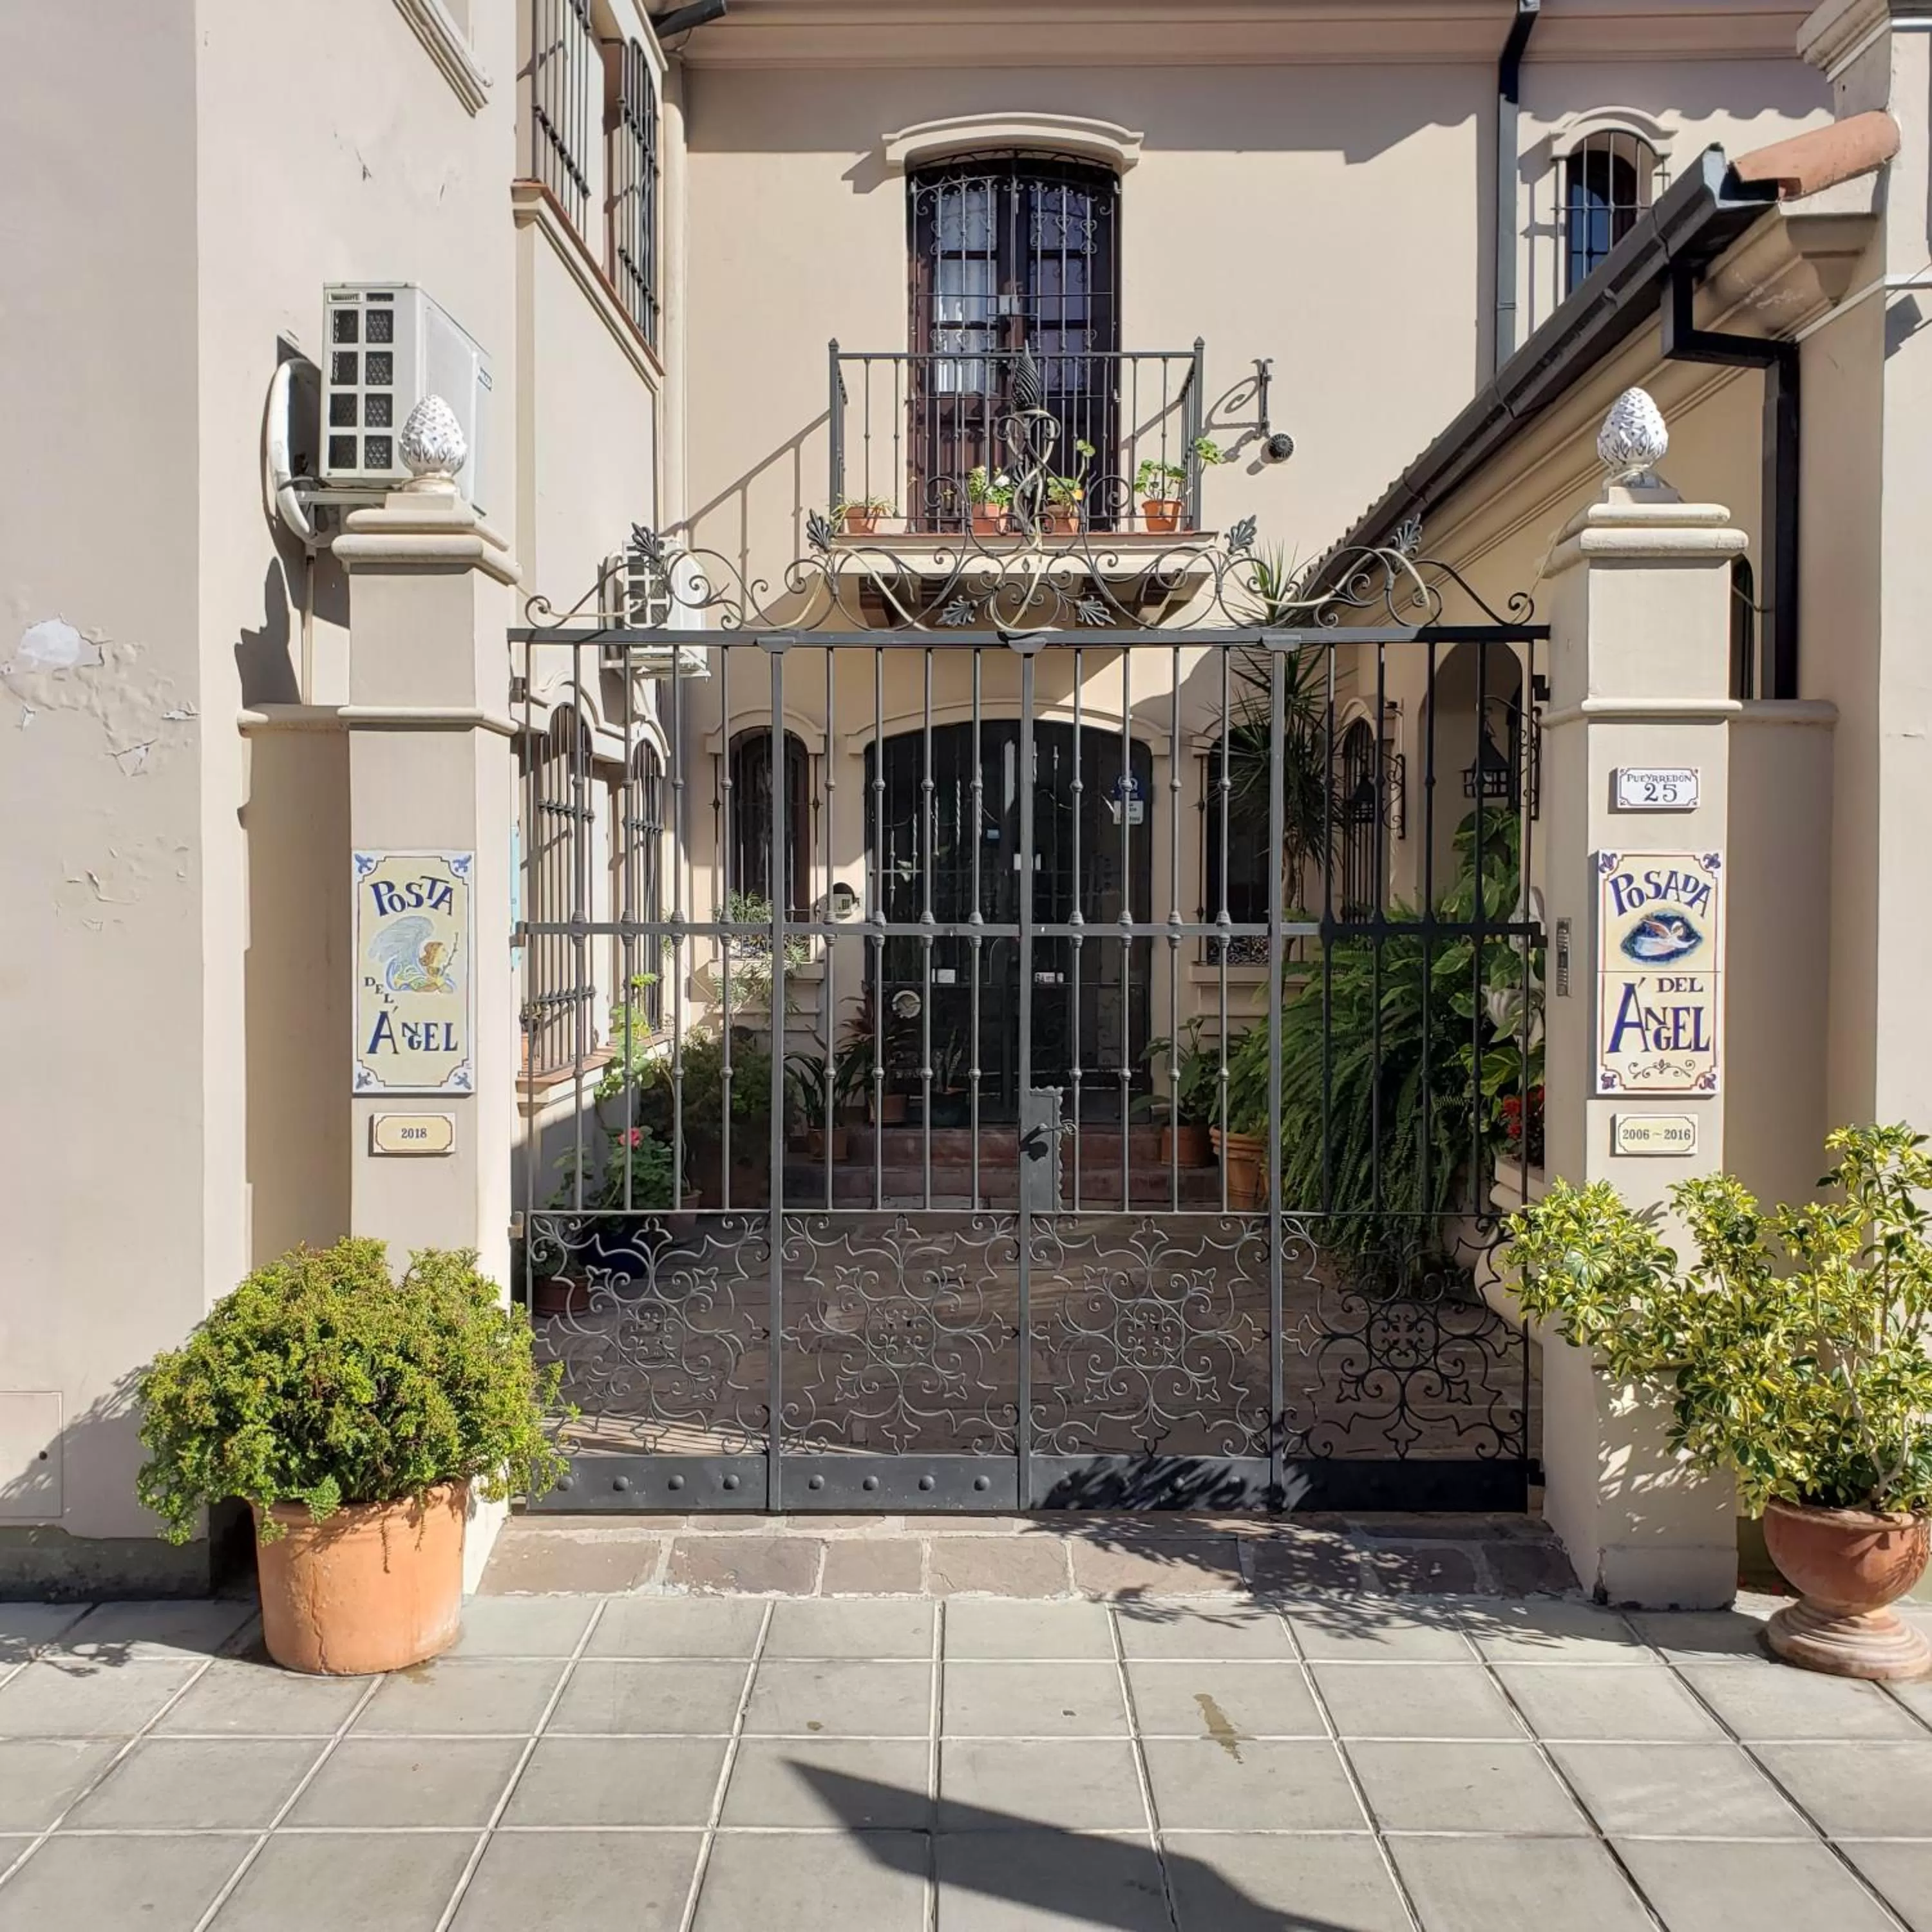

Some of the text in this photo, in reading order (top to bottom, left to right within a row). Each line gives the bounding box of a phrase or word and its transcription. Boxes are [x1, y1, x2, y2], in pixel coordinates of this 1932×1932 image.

[1643, 782, 1677, 802] 25
[1656, 977, 1704, 993] DEL
[401, 1128, 428, 1139] 2018
[1622, 1128, 1650, 1140] 2006
[1663, 1128, 1691, 1141] 2016
